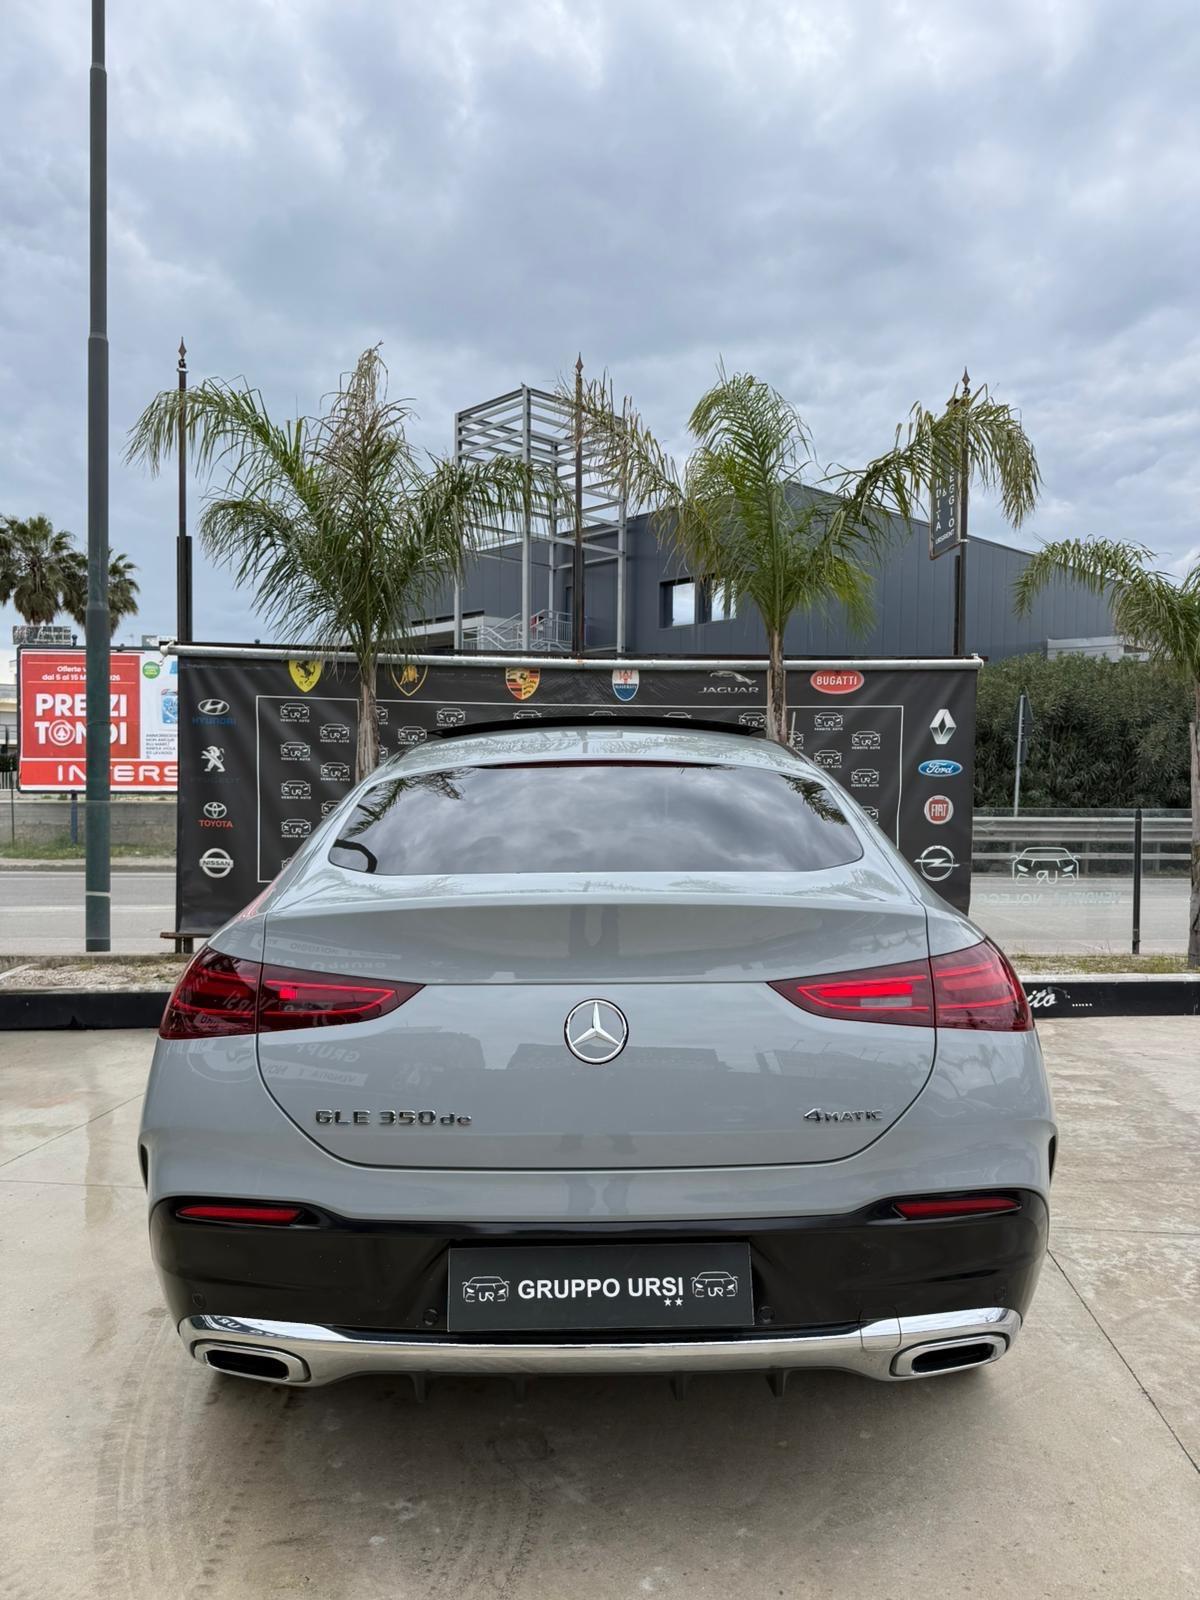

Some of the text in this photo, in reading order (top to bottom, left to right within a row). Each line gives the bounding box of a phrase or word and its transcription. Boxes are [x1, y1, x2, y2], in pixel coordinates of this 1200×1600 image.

[816, 676, 857, 686] BUGATTI
[36, 693, 127, 717] PREZI
[926, 762, 954, 774] Ford
[931, 804, 948, 817] FIAT
[198, 819, 233, 828] TOYOTA
[315, 1109, 472, 1125] GLE 350de
[803, 1107, 883, 1122] 4MATIC
[478, 1276, 724, 1302] UR GRUPPO URSI UR
